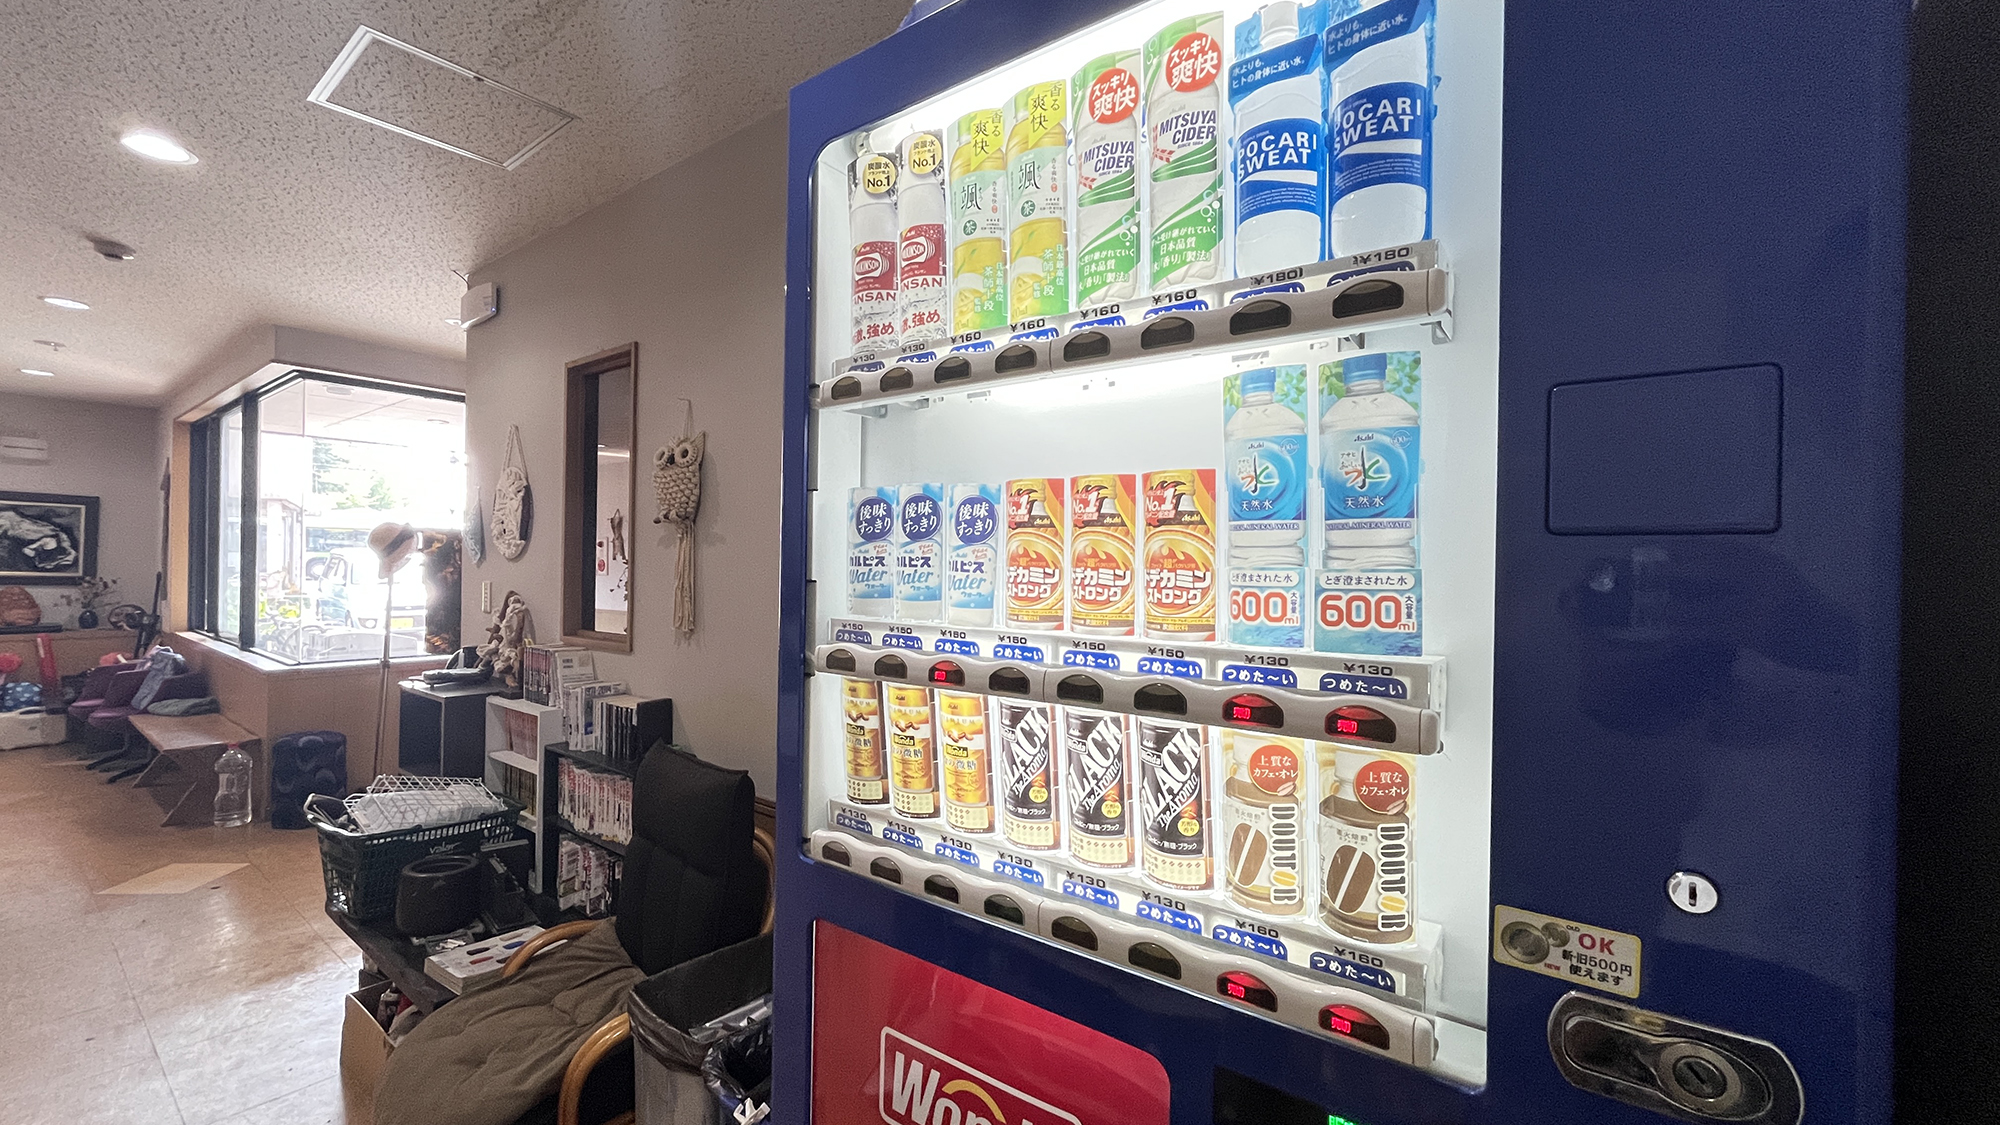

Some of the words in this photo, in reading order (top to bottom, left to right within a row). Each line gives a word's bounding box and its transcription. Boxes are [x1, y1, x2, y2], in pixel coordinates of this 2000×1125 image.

[1328, 19, 1363, 42] 水よりも、
[1328, 13, 1408, 55] ヒトの身体に近い水。
[1170, 36, 1212, 67] スッキリ
[1171, 51, 1218, 90] 爽快
[1232, 59, 1265, 76] 水よりも、
[1232, 56, 1305, 89] ヒトの身体に近い水。
[1092, 71, 1130, 100] スッキリ
[1049, 81, 1062, 111] 香る
[1093, 86, 1136, 122] 爽快
[1031, 93, 1049, 133] 爽快
[1334, 96, 1421, 133] POCARI
[990, 110, 1003, 137] 香る
[1159, 110, 1217, 136] MITSUYA
[913, 139, 936, 150] 炭酸水
[973, 119, 990, 157] 爽快
[1172, 125, 1217, 145] CIDER
[1334, 115, 1414, 156] SWEAT
[1083, 141, 1135, 165] MITSUYA
[1238, 131, 1317, 160] POCARI
[867, 161, 891, 171] 炭酸水
[912, 153, 936, 169] No.1
[1094, 155, 1135, 173] CIDER
[1238, 148, 1311, 180] SWEAT
[867, 175, 891, 188] No.1
[1018, 161, 1041, 190] 颯
[960, 183, 982, 210] 颯
[1022, 201, 1035, 217] 茶
[963, 221, 977, 235] 茶
[1160, 236, 1196, 256] 日本品質
[1360, 247, 1409, 265] ¥180
[1043, 249, 1055, 296] 茶師十段
[1084, 259, 1116, 277] 日本品質
[1254, 270, 1299, 285] ¥180
[983, 267, 994, 311] 茶師十段
[1152, 289, 1197, 305] ¥160
[1081, 304, 1120, 320] ¥160
[1010, 318, 1045, 332] ¥160
[951, 331, 981, 345] ¥160
[853, 353, 875, 363] ¥130
[901, 343, 925, 354] ¥130
[1354, 434, 1374, 442] Asahi
[1241, 454, 1277, 494] 水
[1344, 446, 1391, 490] 水
[905, 500, 933, 517] 後味
[1074, 491, 1100, 513] No.1
[1146, 488, 1176, 511] No.1
[1242, 500, 1273, 511] 天然水
[1345, 496, 1385, 509] 天然水
[860, 503, 887, 520] 後味
[960, 501, 989, 520] 後味
[1182, 514, 1201, 522] Asahi
[858, 518, 891, 535] すっきり
[904, 516, 937, 535] すっきり
[957, 518, 993, 538] すっきり
[1275, 522, 1299, 530] WATER
[1386, 520, 1411, 528] WATER
[1231, 573, 1293, 583] とぎ澄まされた水
[1324, 575, 1408, 586] とぎ澄まされた水
[1147, 588, 1201, 605] ストロング
[1405, 595, 1414, 619] 大容量
[1072, 640, 1105, 651] ¥150
[1148, 646, 1184, 659] ¥150
[1244, 654, 1289, 667] ¥130
[1343, 663, 1393, 676] ¥130
[1022, 747, 1048, 784] Aroma
[1069, 716, 1122, 813] BLACK
[1258, 755, 1292, 766] 上質な
[1093, 759, 1121, 799] Aroma
[1142, 728, 1200, 830] BLACK
[1253, 767, 1298, 779] カフェ・オ・レ
[1366, 771, 1402, 784] 上質な
[1169, 774, 1199, 813] Aroma
[1359, 785, 1409, 796] カフェ・オ・レ
[841, 806, 867, 821] ¥130
[887, 819, 916, 835] ¥130
[940, 834, 973, 851] ¥130
[997, 850, 1033, 869] ¥130
[1271, 805, 1298, 902] DOUTOR
[1066, 870, 1106, 889] ¥130
[1379, 825, 1407, 930] DOUTOR
[1141, 890, 1186, 912] ¥130
[1234, 919, 1280, 939] ¥160
[1566, 924, 1581, 933] OLD
[1578, 933, 1615, 956] OK
[1333, 945, 1384, 968] ¥160
[1544, 962, 1561, 972] NEW
[1569, 963, 1624, 986] 使えます
